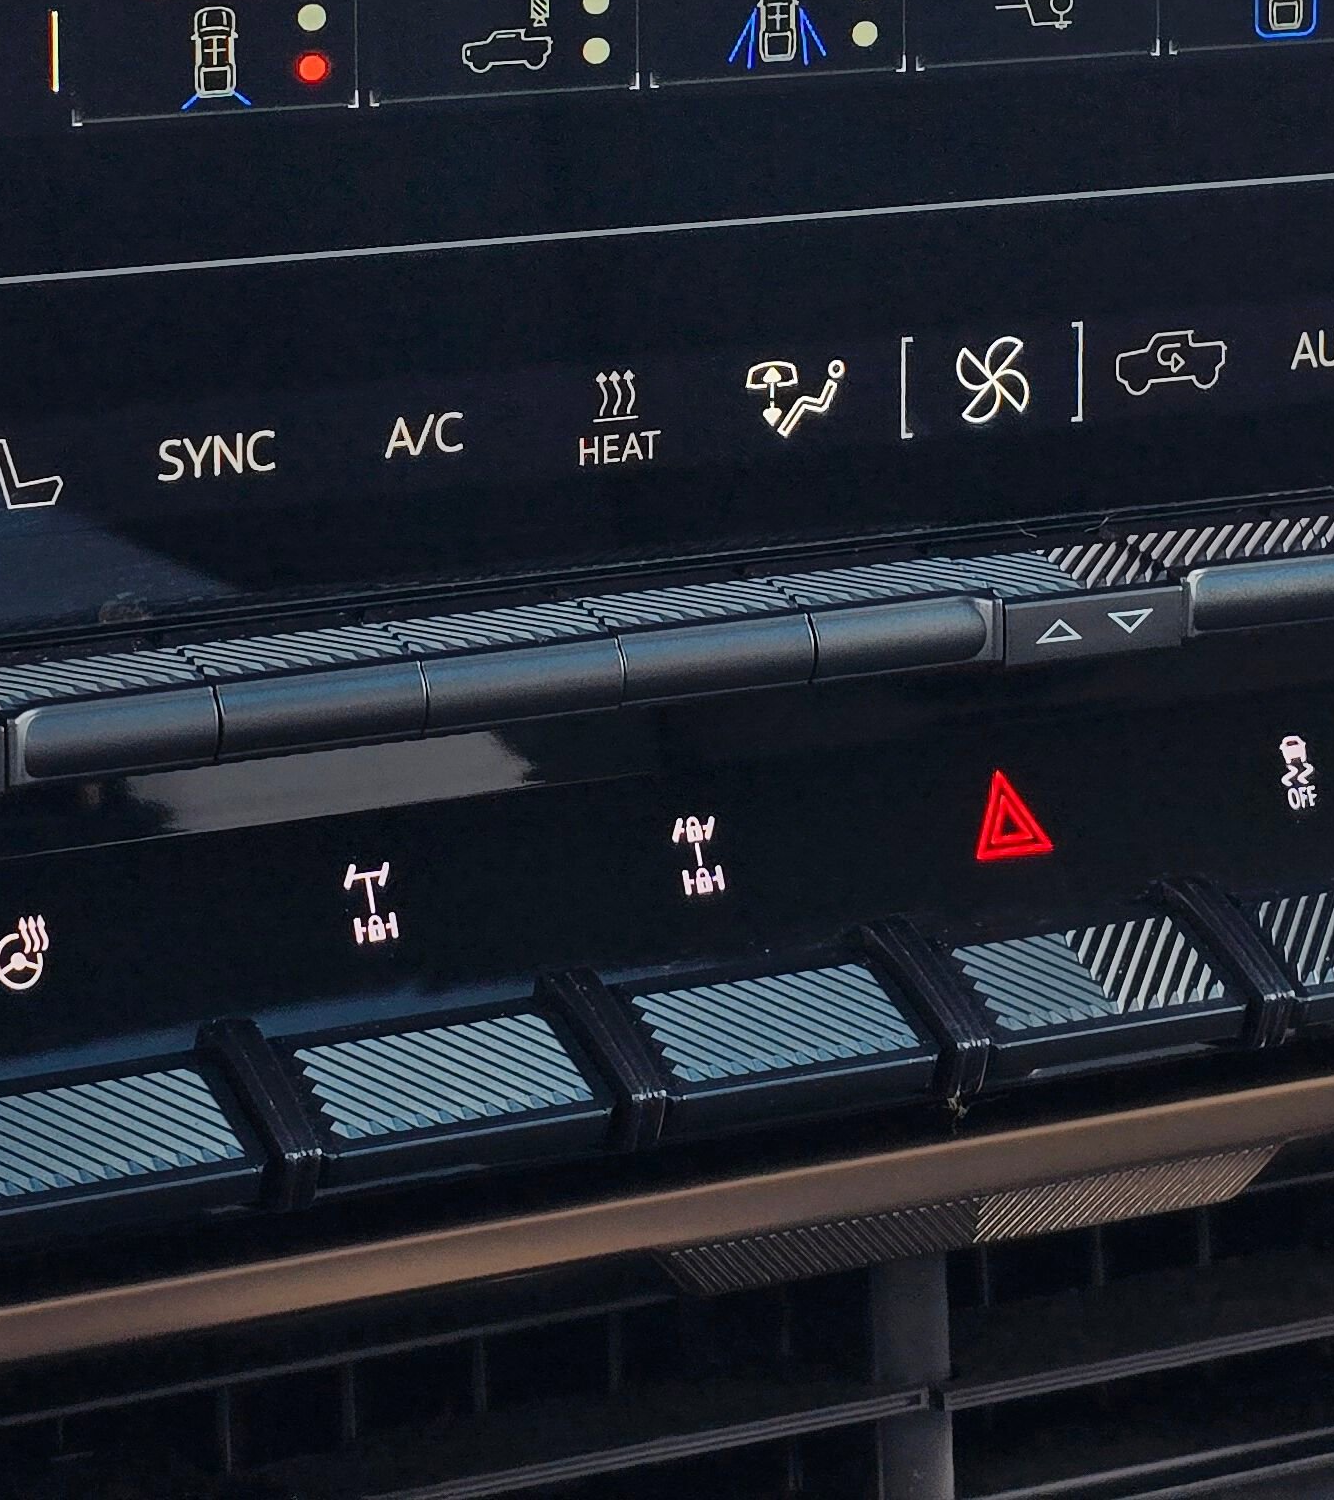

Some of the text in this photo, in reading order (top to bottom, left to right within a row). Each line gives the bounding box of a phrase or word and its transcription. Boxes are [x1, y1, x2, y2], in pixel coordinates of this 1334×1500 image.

[157, 429, 276, 482] SYNC
[384, 411, 465, 460] A/C
[578, 429, 662, 467] HEAT
[1287, 784, 1318, 810] OFF
